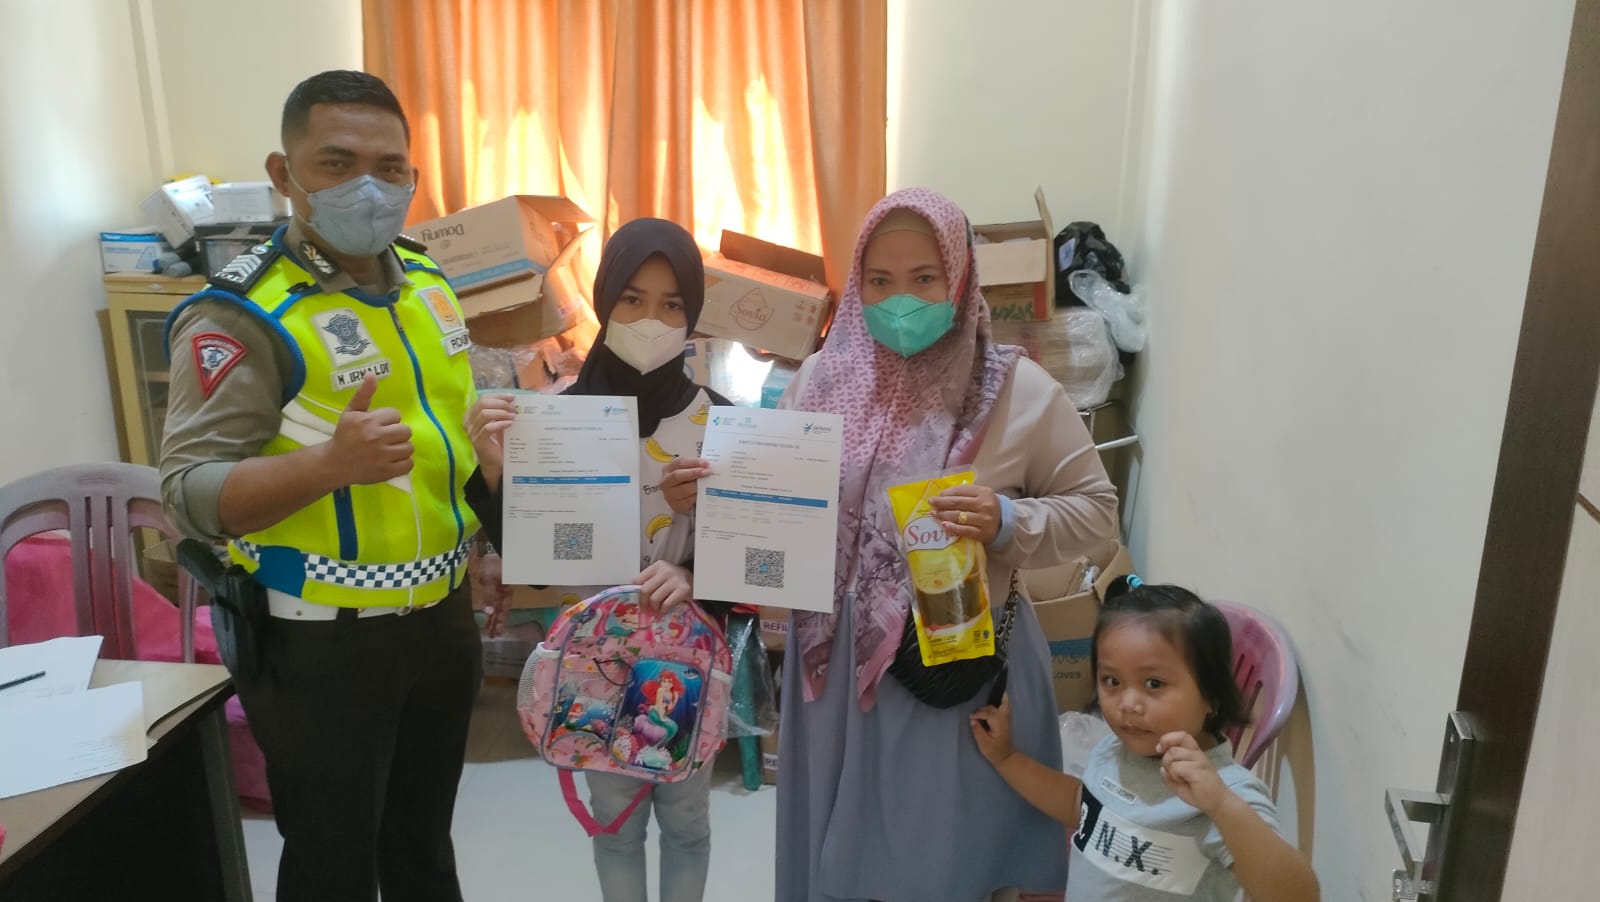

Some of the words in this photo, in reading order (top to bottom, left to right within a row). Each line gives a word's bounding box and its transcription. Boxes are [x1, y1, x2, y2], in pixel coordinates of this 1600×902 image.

[420, 224, 465, 242] Downy
[734, 303, 767, 321] Sovia
[763, 621, 788, 632] REFIL
